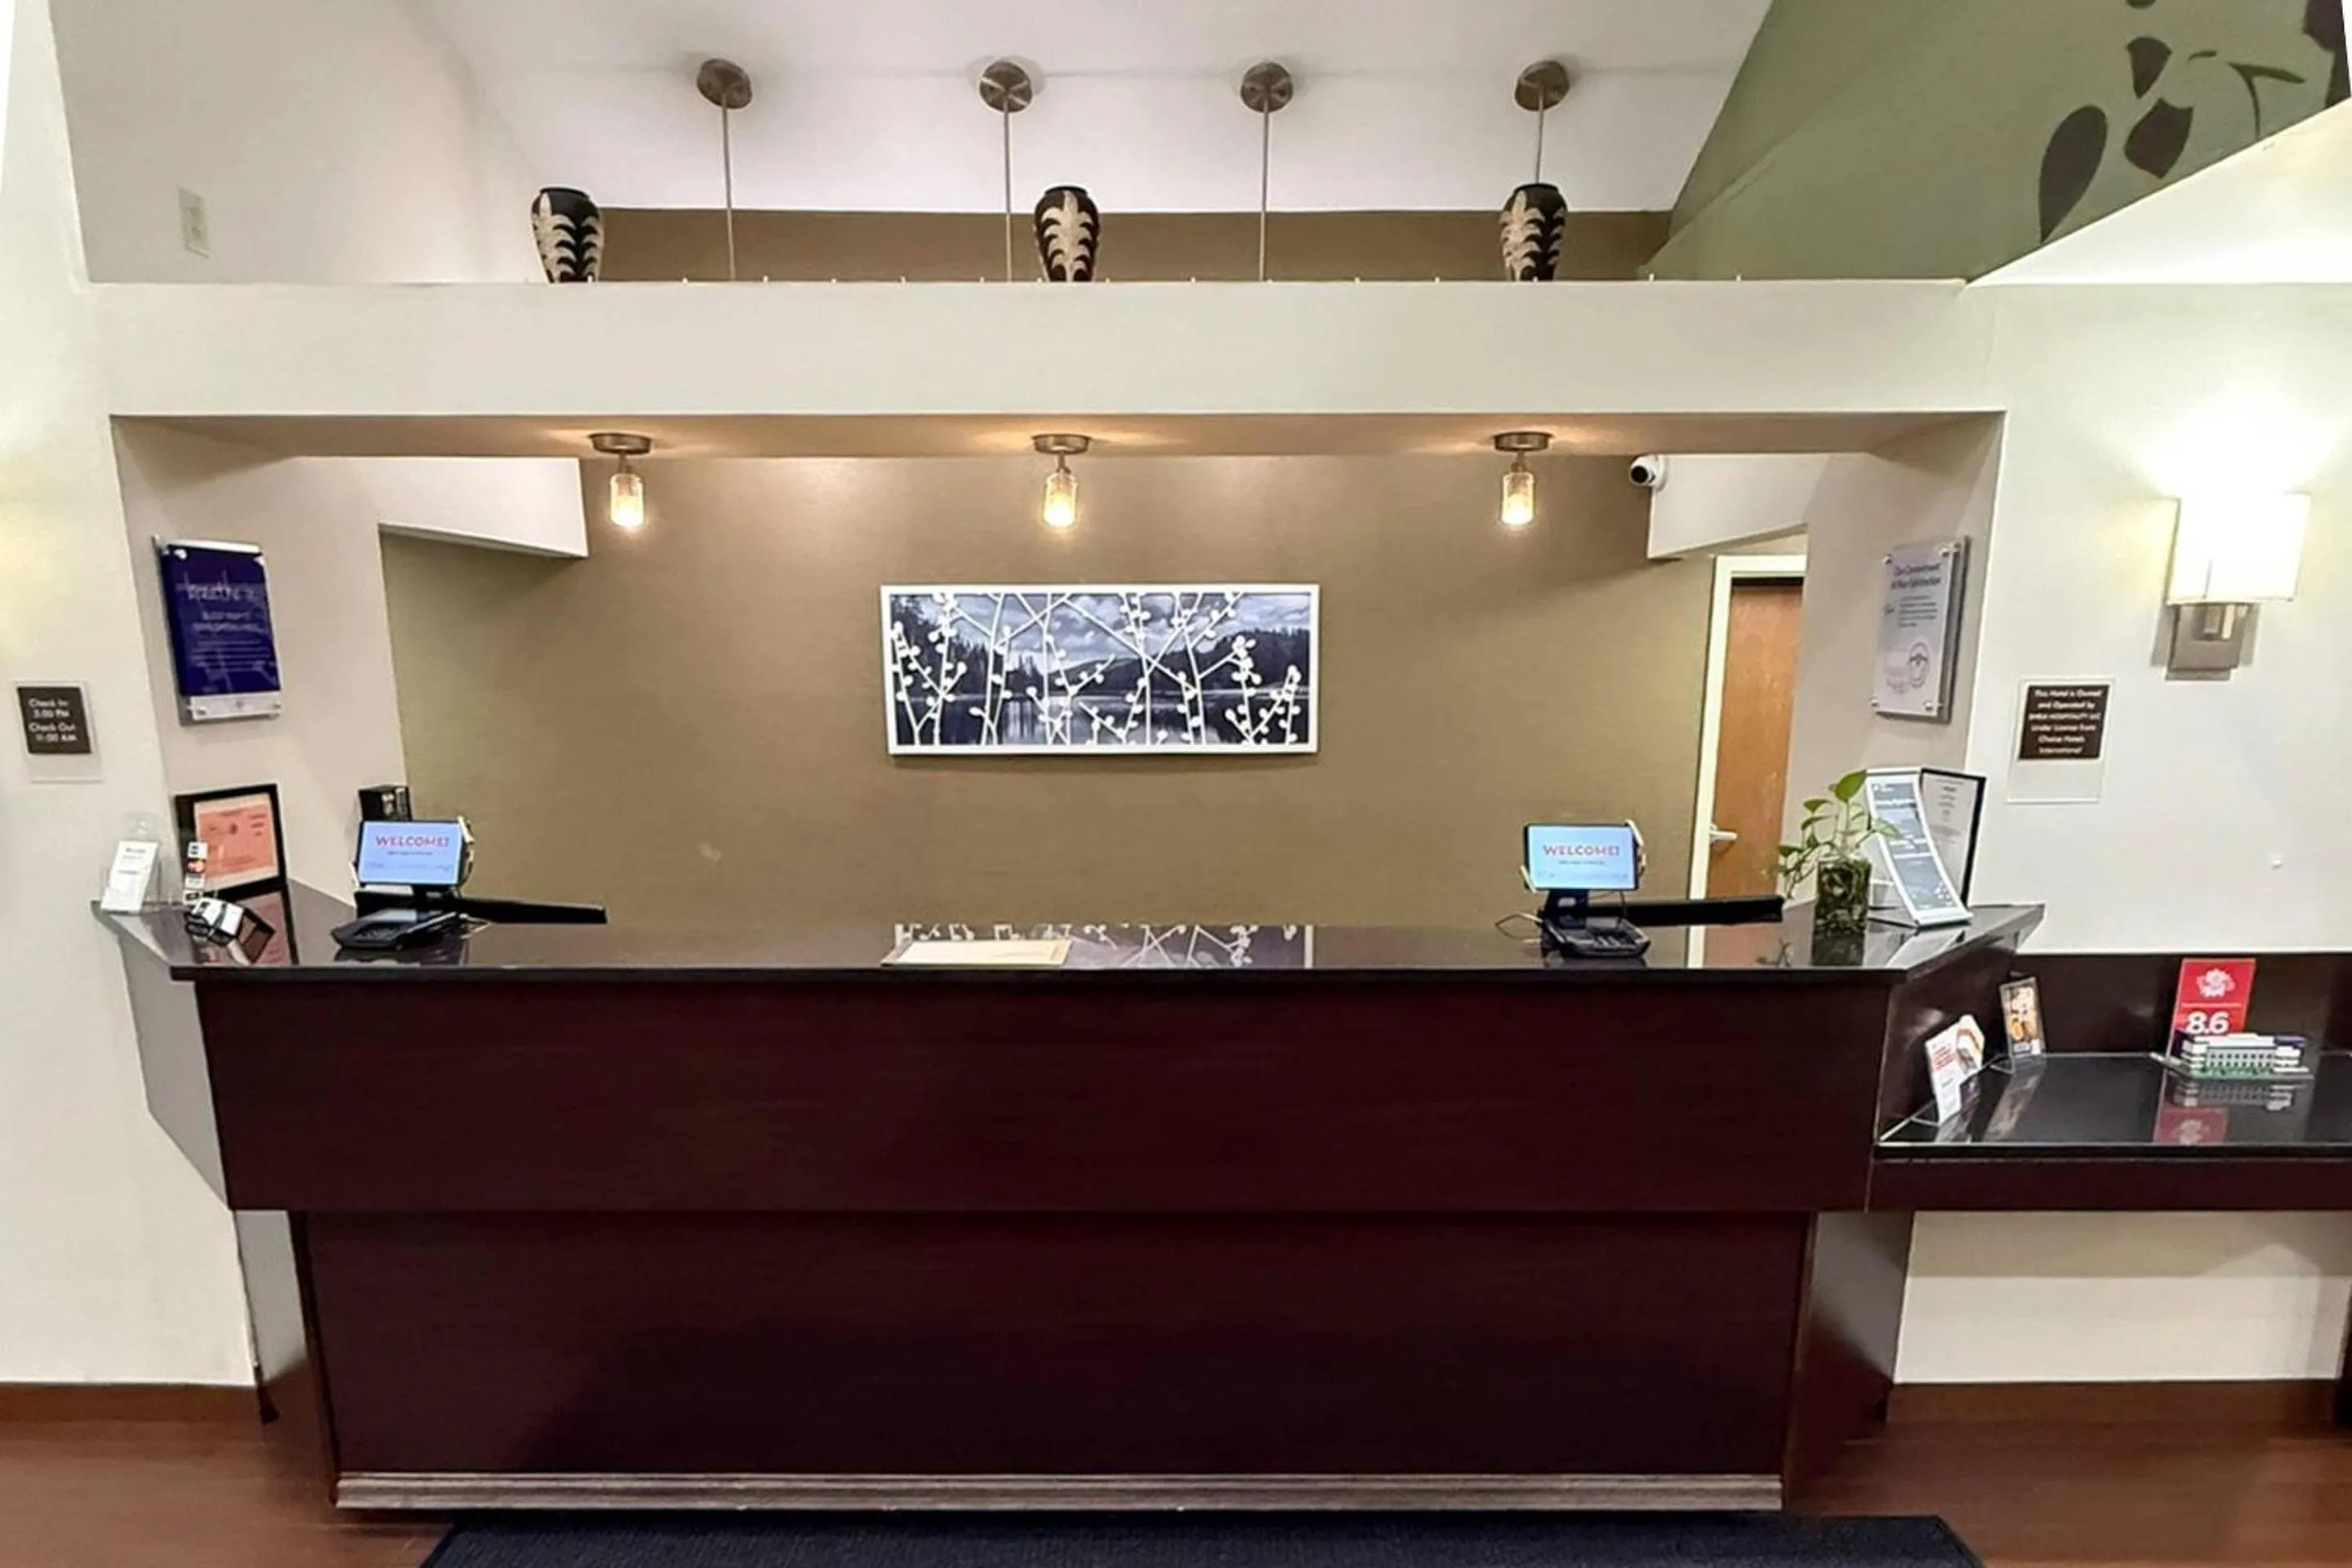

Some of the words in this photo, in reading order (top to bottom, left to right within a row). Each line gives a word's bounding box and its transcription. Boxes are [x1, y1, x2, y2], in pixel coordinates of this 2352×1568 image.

[29, 697, 56, 708] Check
[2037, 701, 2051, 709] and
[2052, 701, 2085, 710] Operated
[2087, 701, 2096, 710] by
[29, 722, 56, 733] Check
[58, 722, 76, 732] Out
[376, 835, 449, 848] WELCOME!
[1543, 844, 1620, 856] WELCOME!
[2185, 1009, 2230, 1035] 8.6
